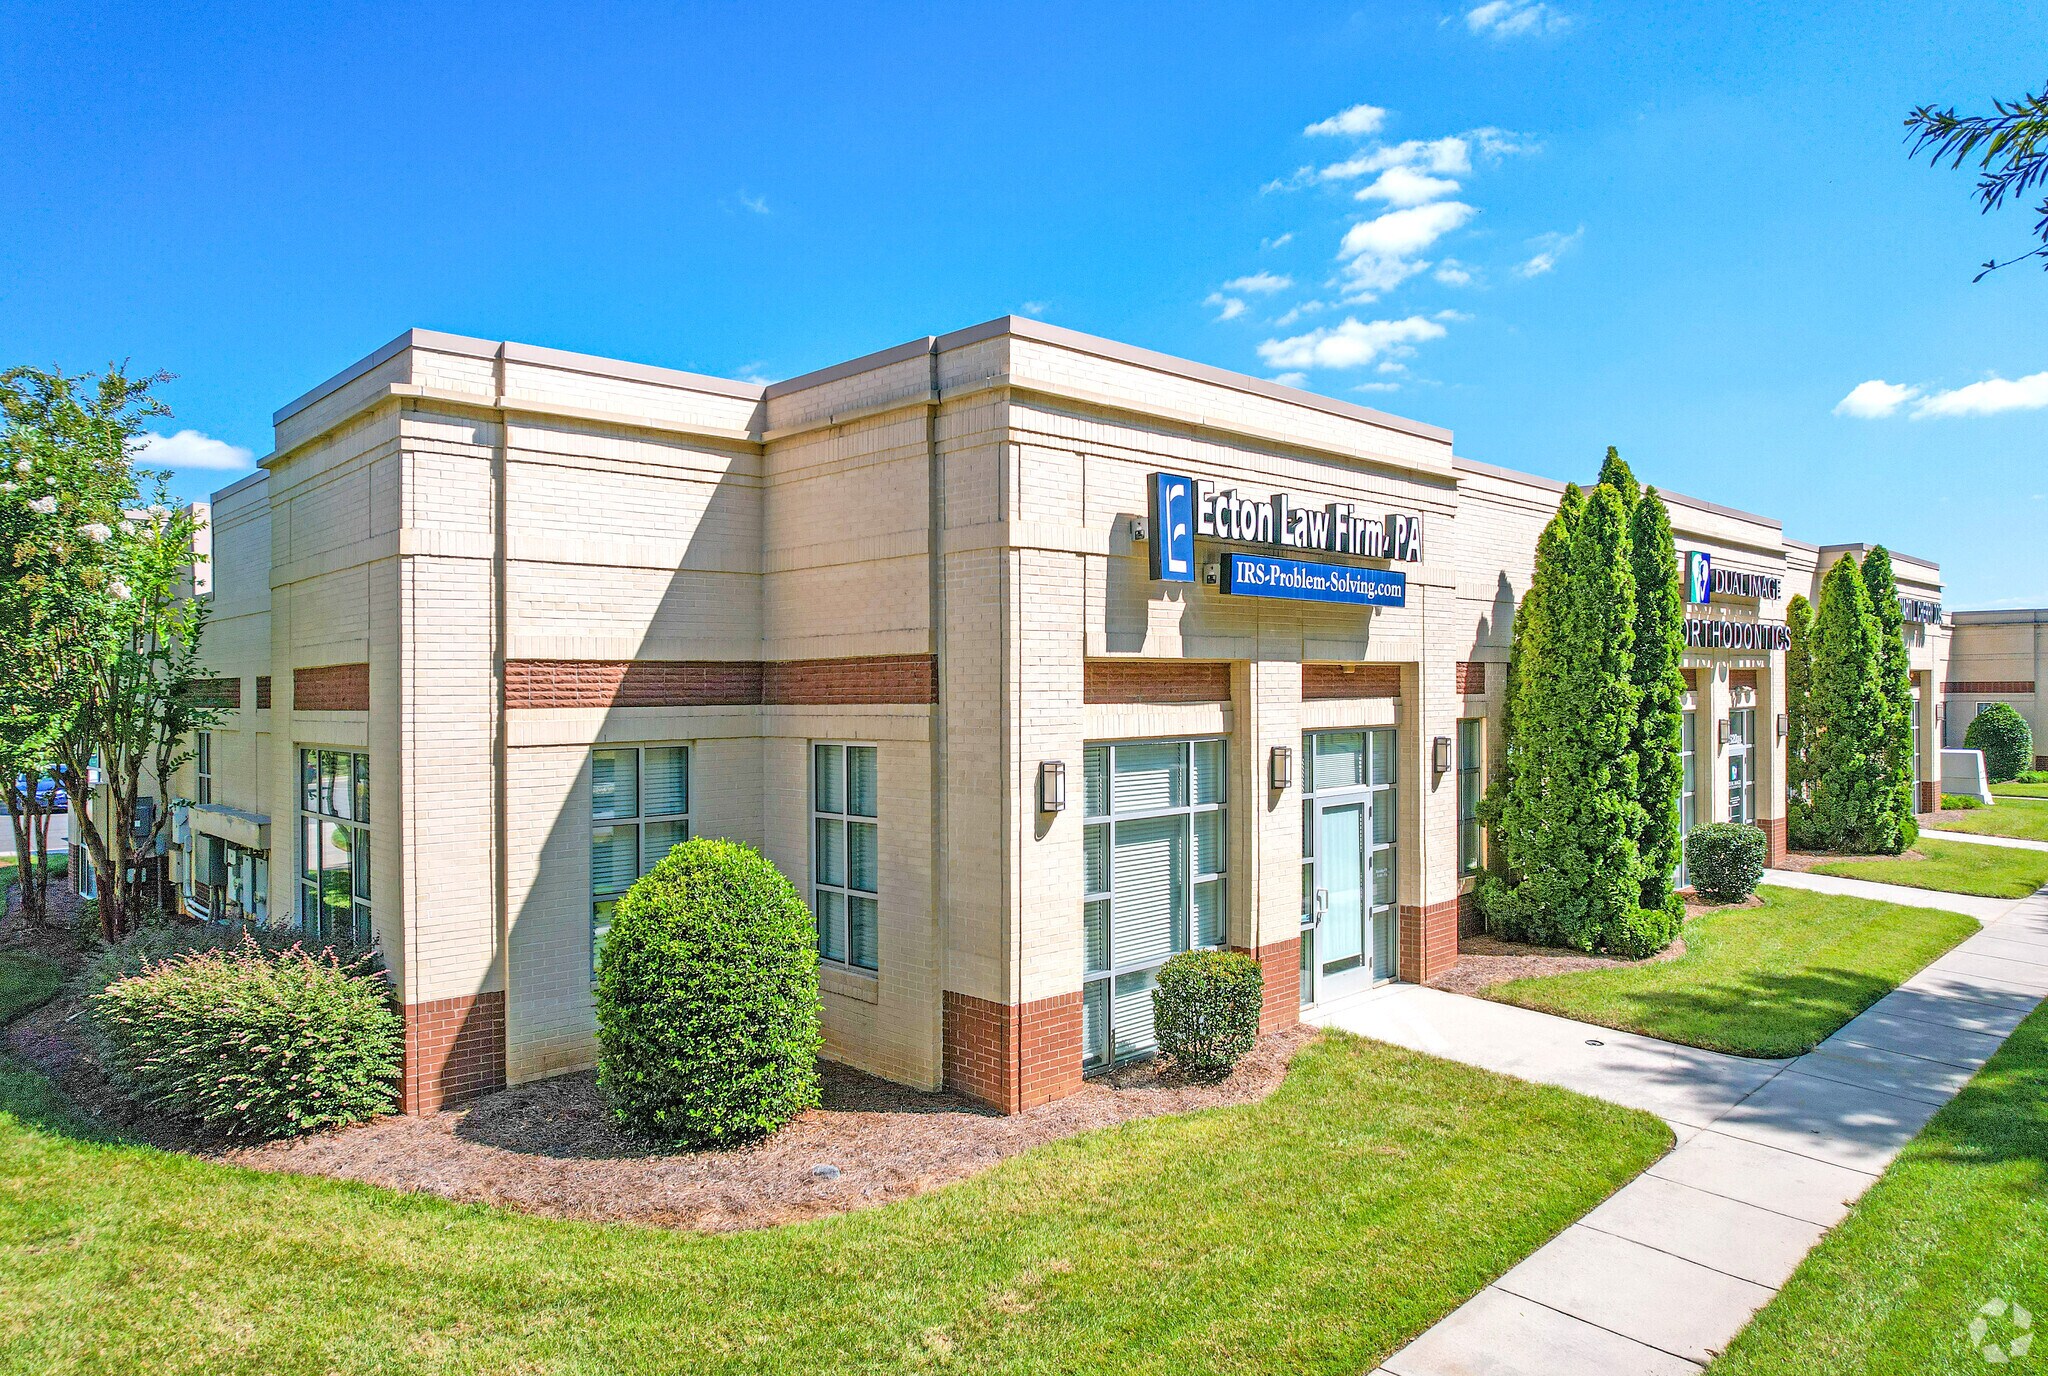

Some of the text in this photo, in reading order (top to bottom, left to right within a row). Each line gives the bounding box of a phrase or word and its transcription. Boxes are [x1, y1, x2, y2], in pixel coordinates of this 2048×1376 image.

[1196, 479, 1422, 562] Ecton Law Firm, PA
[1236, 561, 1402, 599] IRS-Problem-Solving.com
[1715, 569, 1781, 600] DUAL IMAGE
